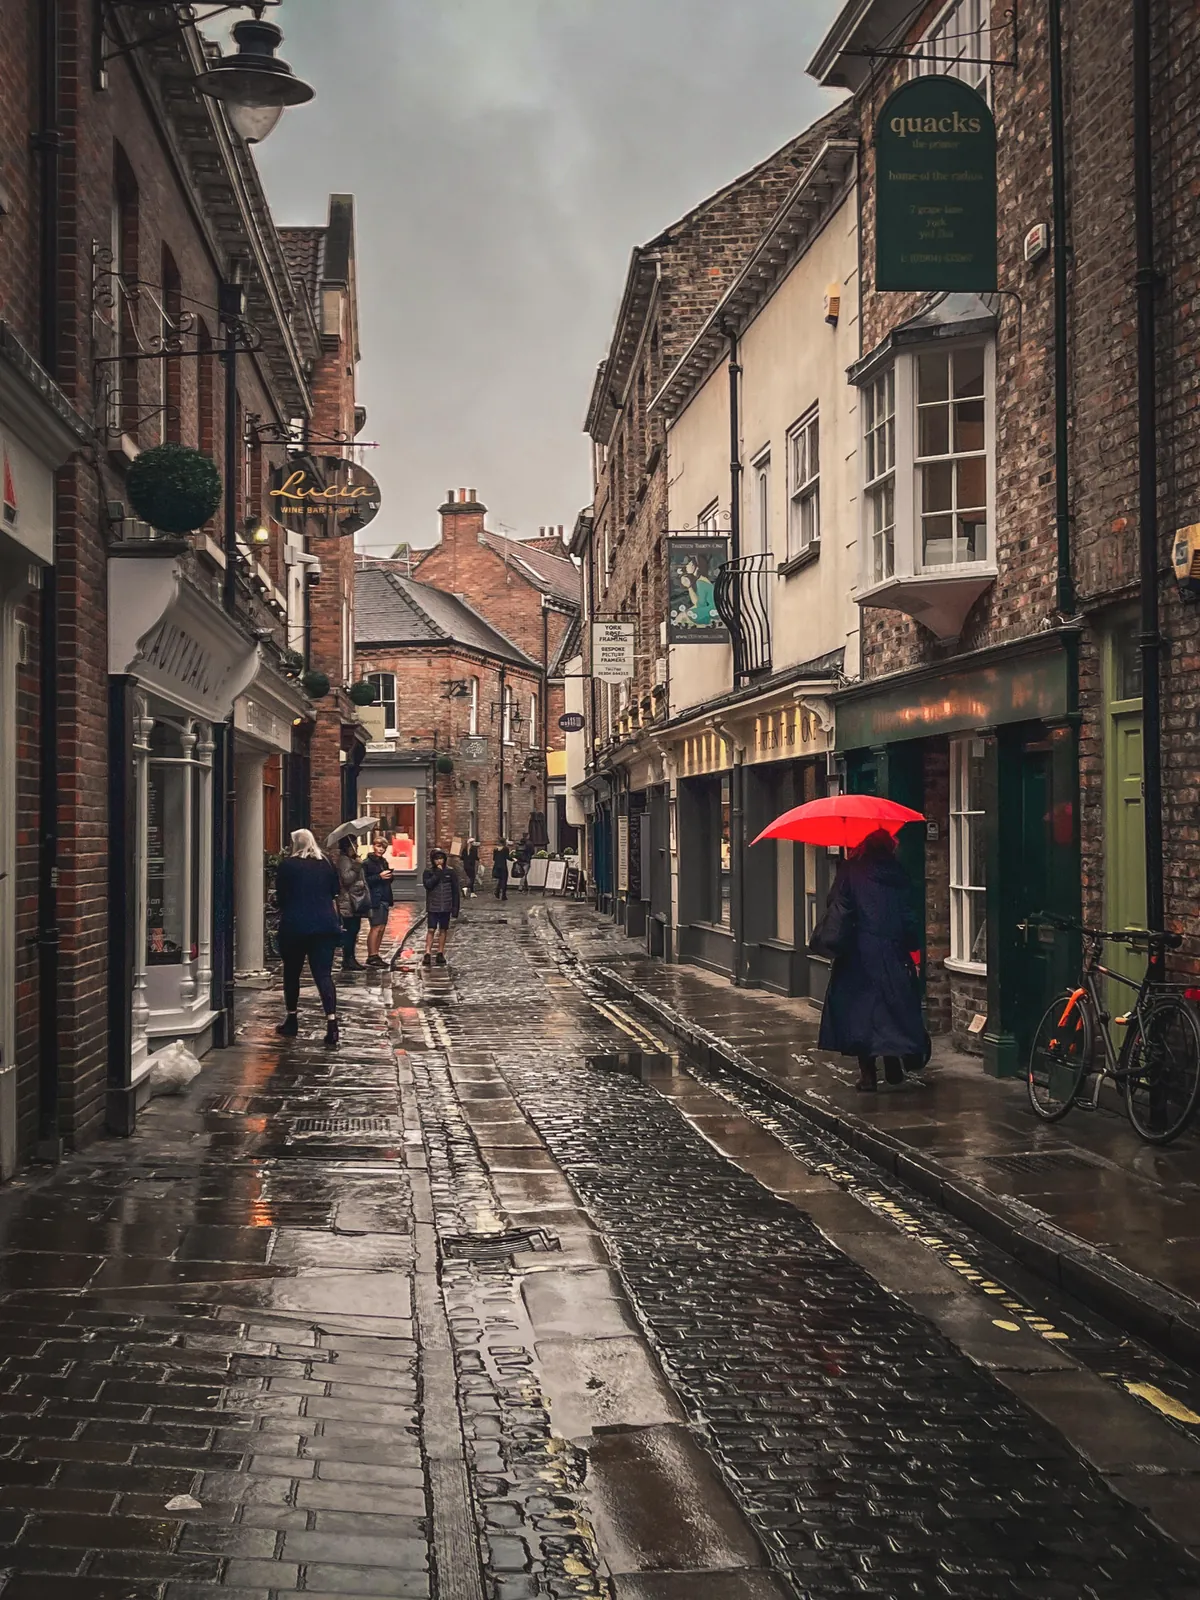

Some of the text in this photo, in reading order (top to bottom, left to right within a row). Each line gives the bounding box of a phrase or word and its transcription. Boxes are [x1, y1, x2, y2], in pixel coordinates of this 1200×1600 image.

[890, 111, 981, 137] quacks
[888, 169, 919, 181] home
[931, 170, 949, 181] the
[269, 470, 375, 500] Lucia
[280, 506, 304, 514] WINE
[306, 506, 325, 514] BAR
[336, 506, 363, 514] GRILL
